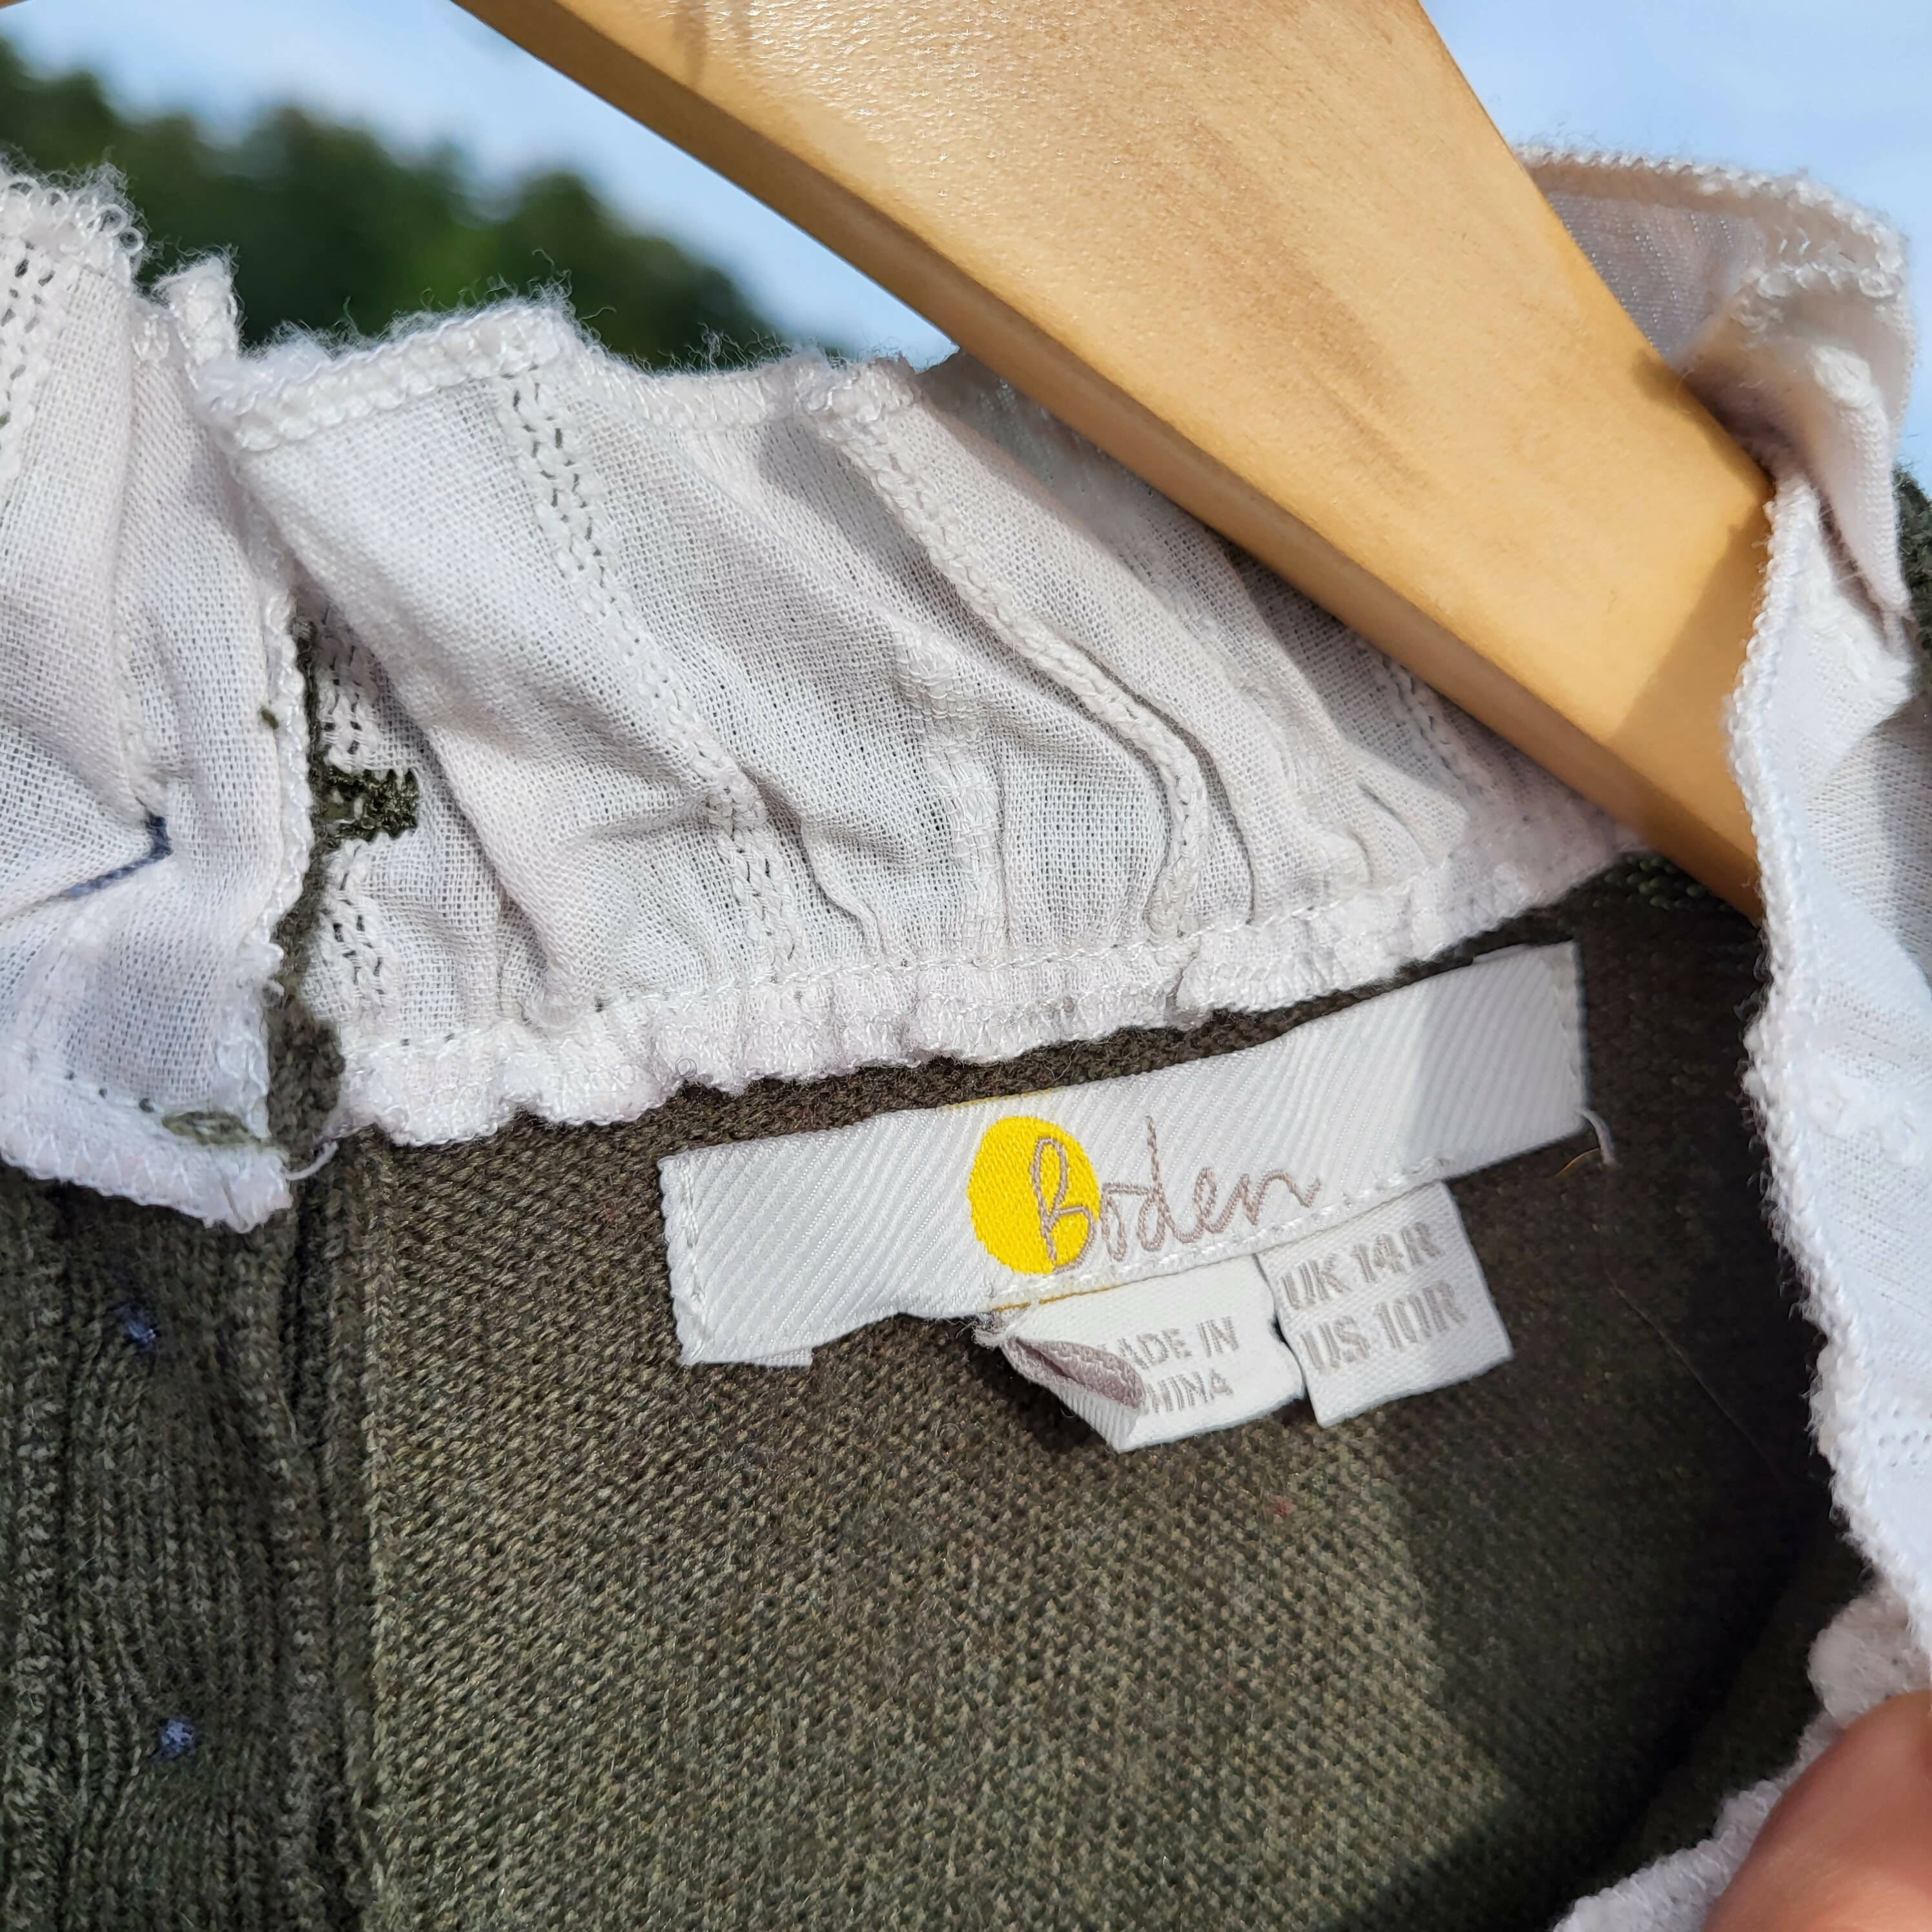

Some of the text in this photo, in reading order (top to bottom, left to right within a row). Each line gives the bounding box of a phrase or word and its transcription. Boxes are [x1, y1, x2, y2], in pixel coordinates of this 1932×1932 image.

[1029, 1115, 1321, 1275] Boden
[1280, 1221, 1441, 1311] UK 14R
[1100, 1315, 1239, 1370] ADE IN
[1300, 1280, 1467, 1373] US 10R
[1140, 1369, 1233, 1415] HINA
